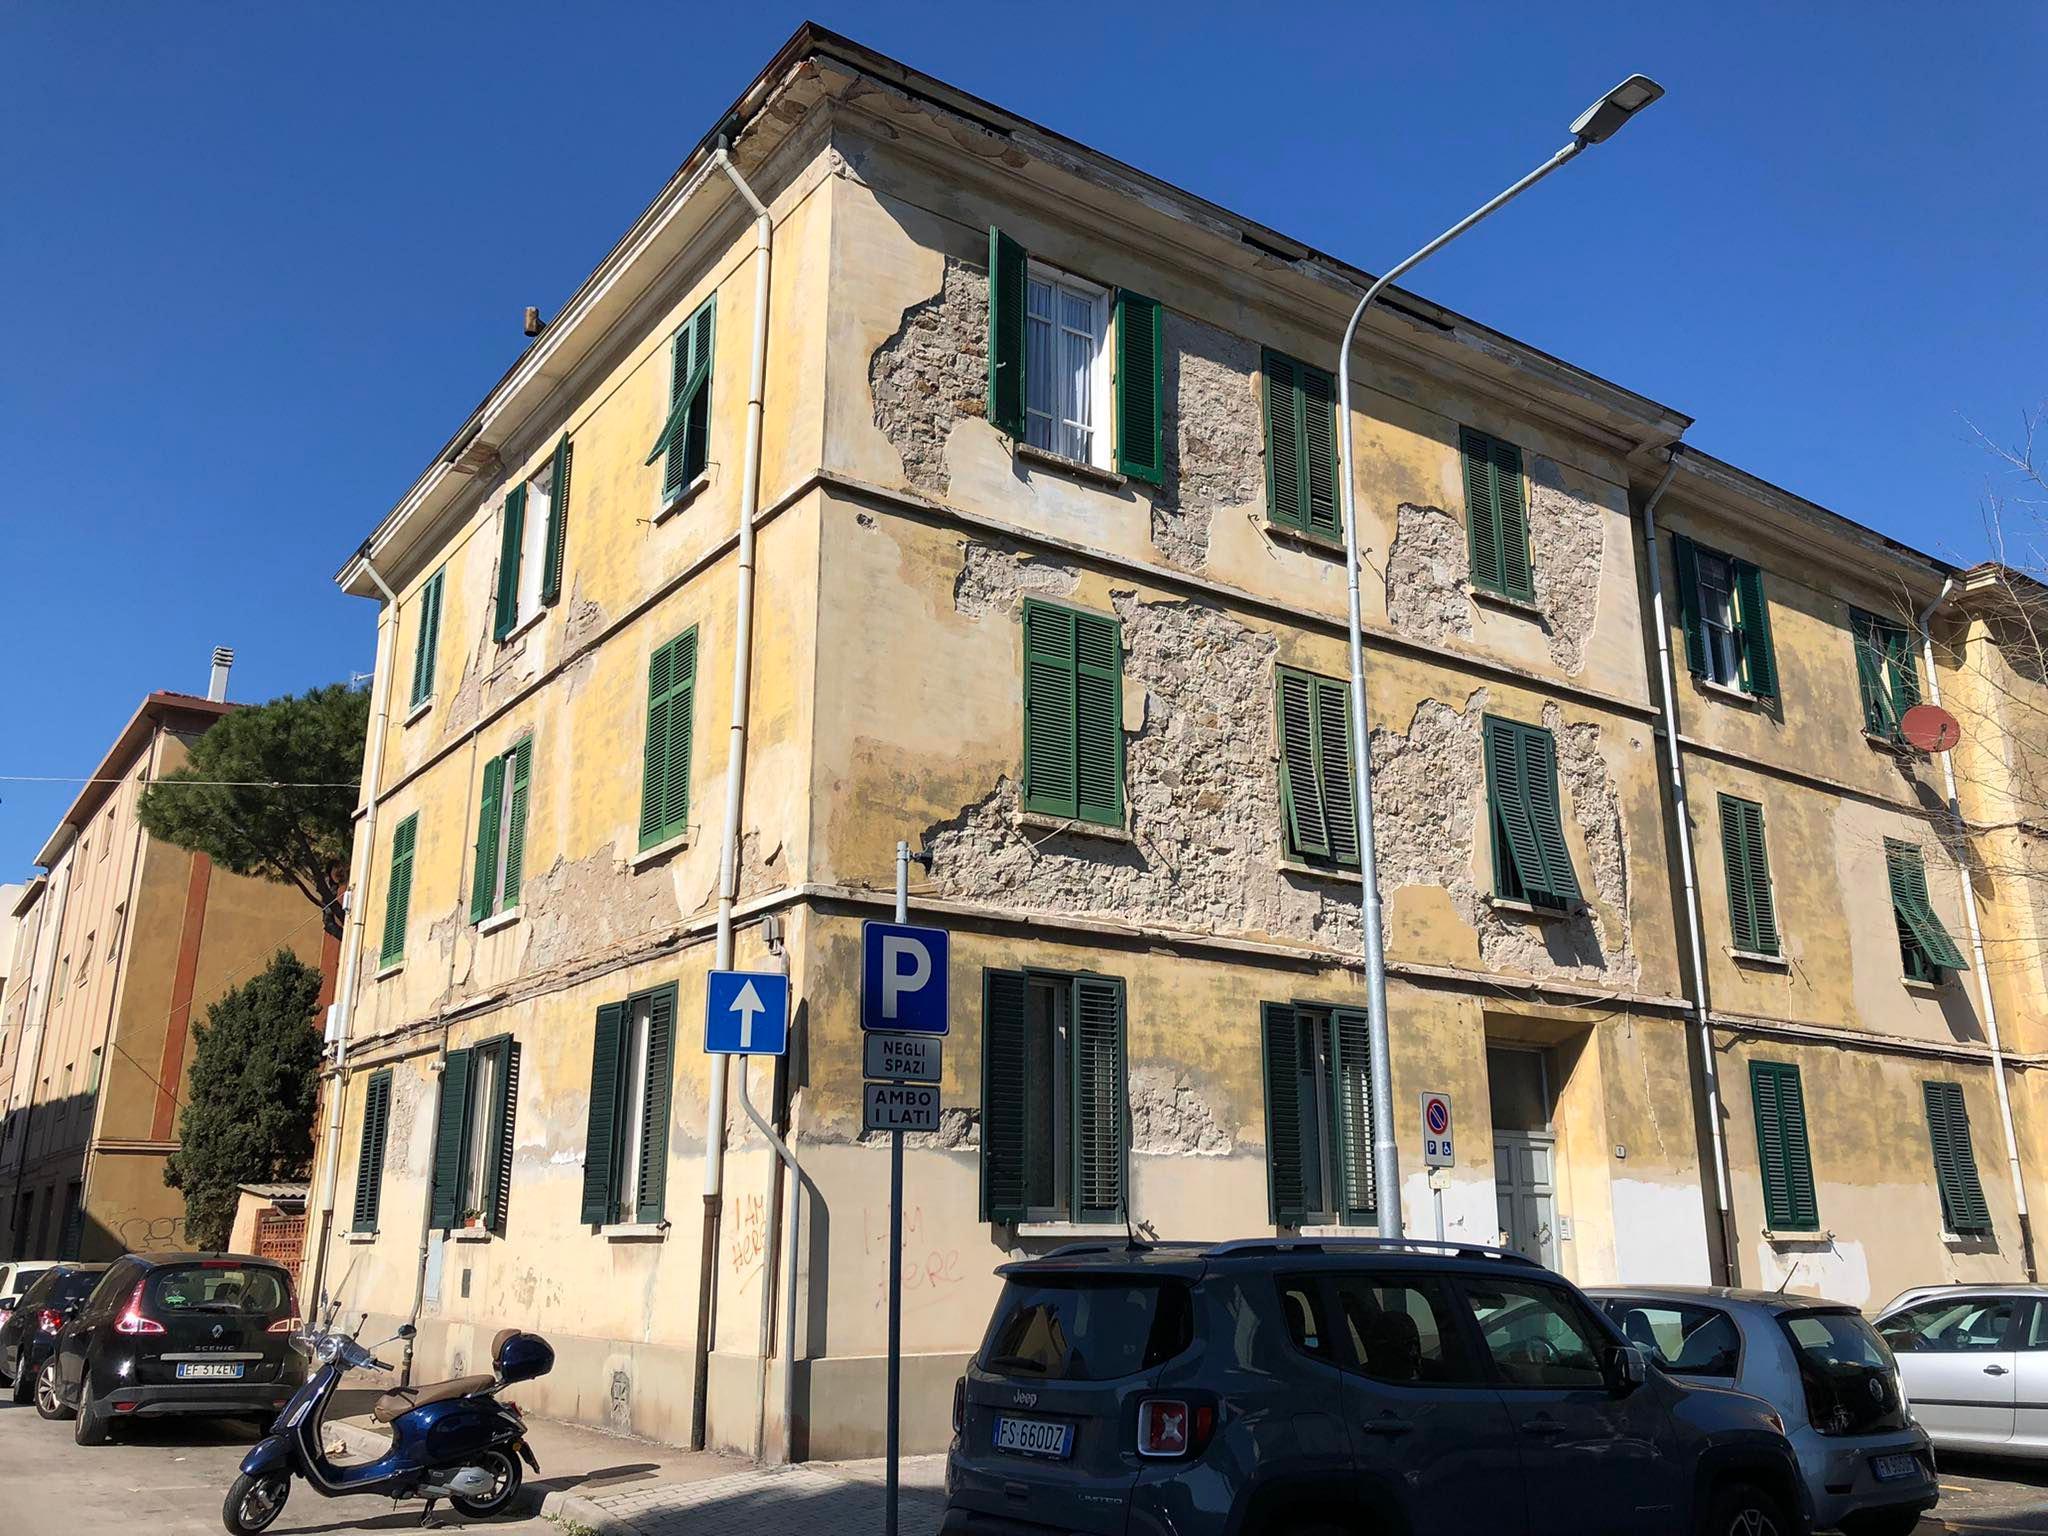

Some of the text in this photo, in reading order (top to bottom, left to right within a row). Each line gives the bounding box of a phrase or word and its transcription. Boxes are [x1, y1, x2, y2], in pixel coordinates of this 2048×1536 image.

[882, 935, 932, 1019] P
[883, 1040, 926, 1057] NEGLI
[884, 1058, 925, 1075] SPAZI
[875, 1090, 932, 1107] AMBO
[875, 1108, 931, 1125] I LATI
[1013, 1388, 1037, 1407] Jeep
